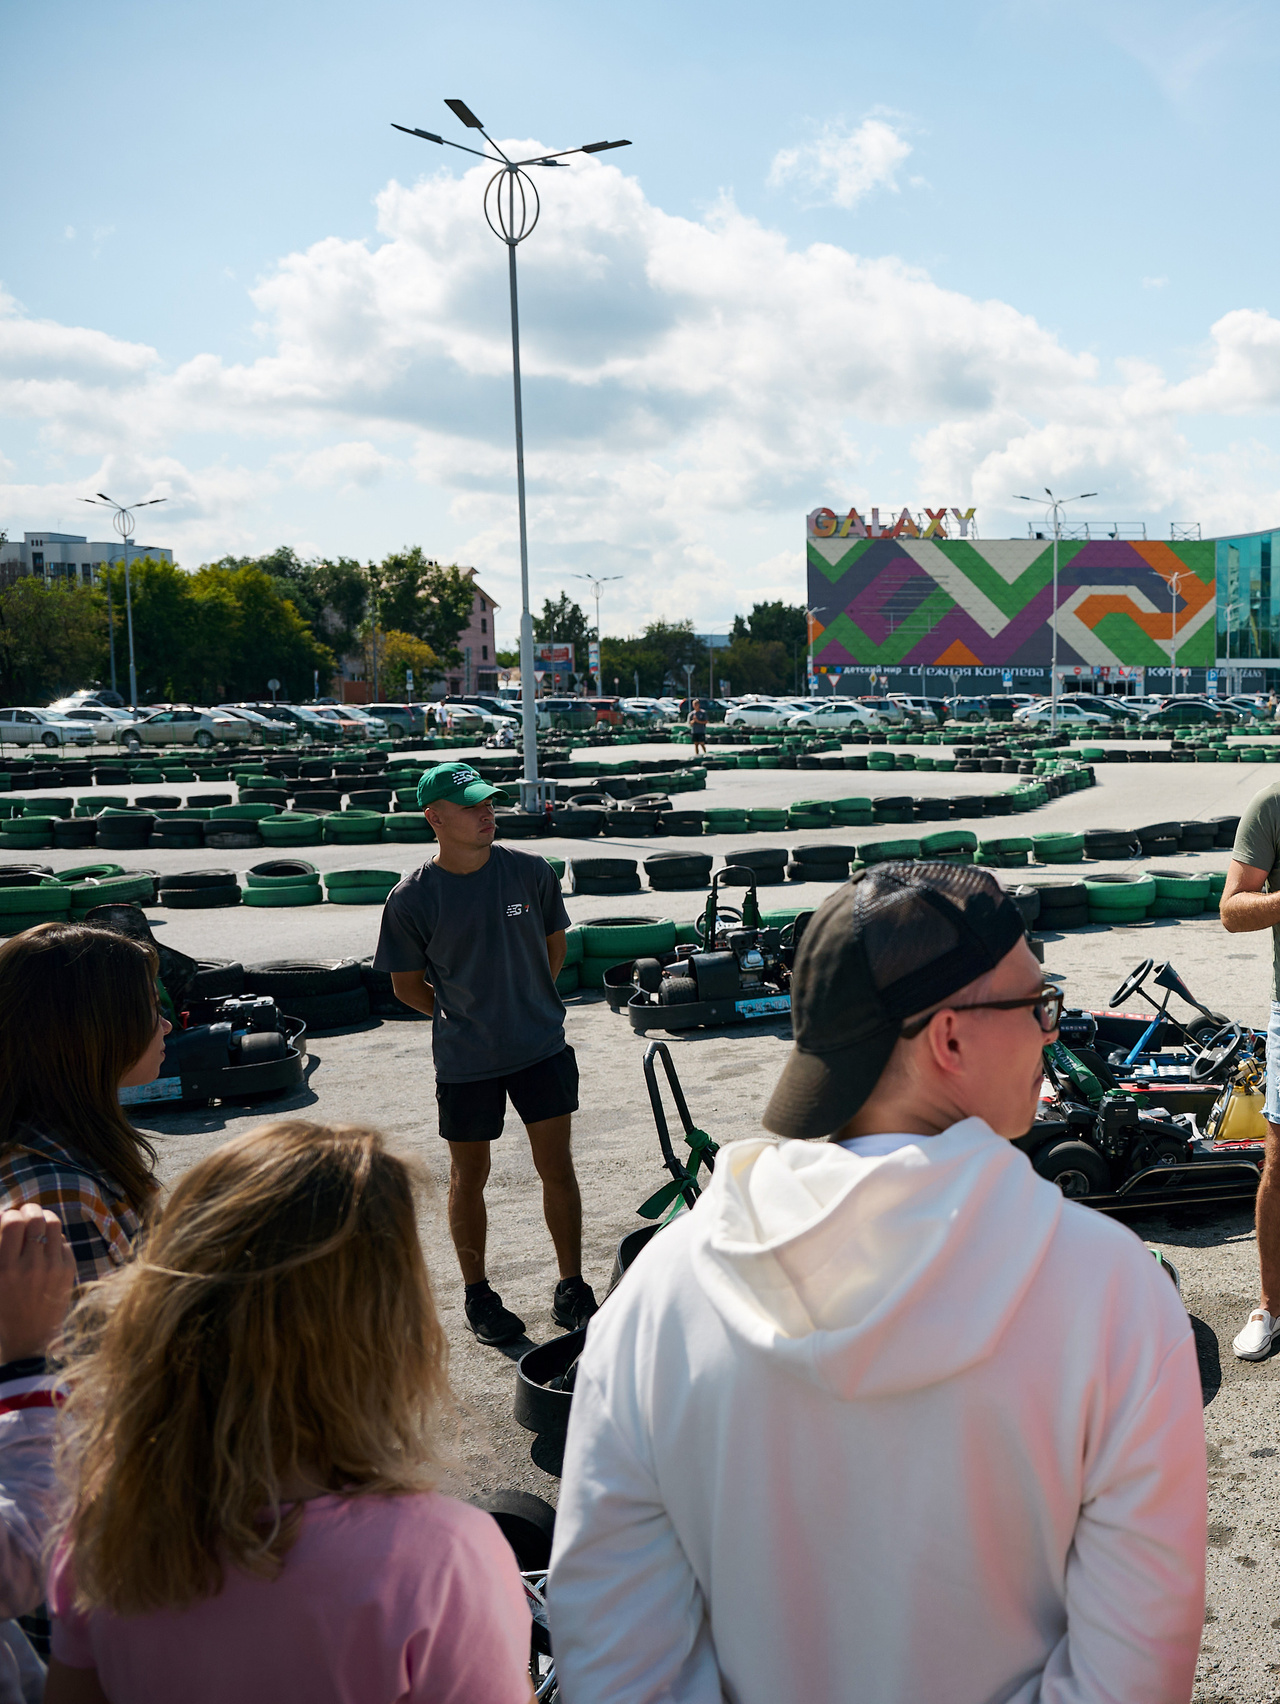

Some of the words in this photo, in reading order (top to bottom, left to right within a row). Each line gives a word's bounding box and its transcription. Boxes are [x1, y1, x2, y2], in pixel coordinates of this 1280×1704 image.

[808, 507, 977, 538] GALAXY
[843, 665, 882, 674] детский
[883, 666, 902, 675] мир
[975, 666, 1044, 677] Королева
